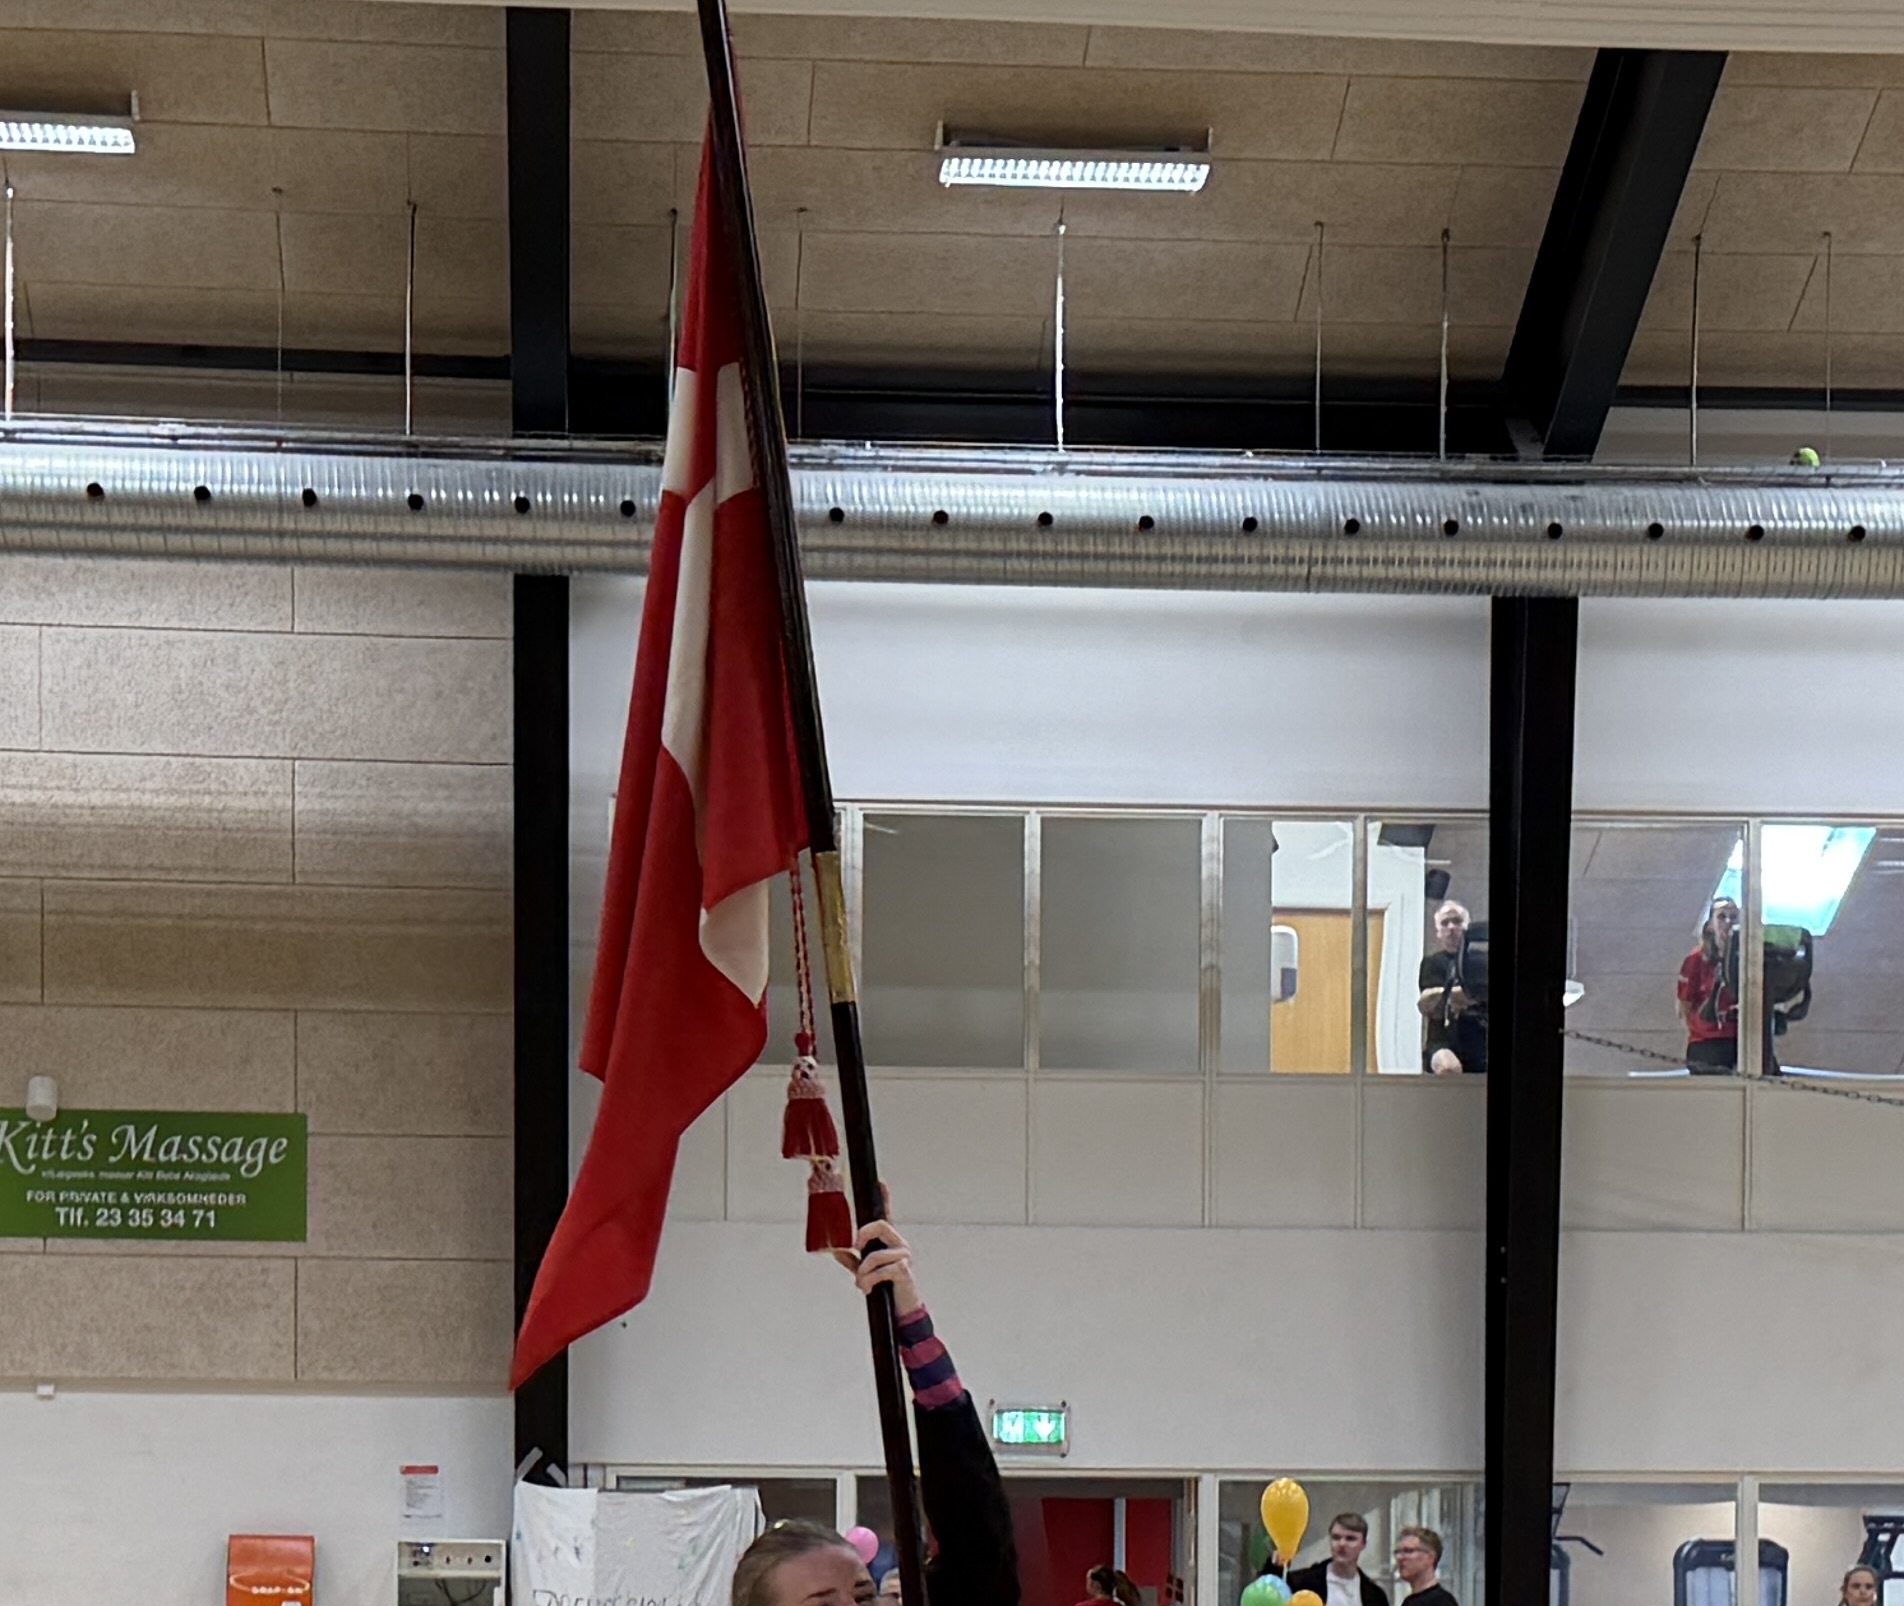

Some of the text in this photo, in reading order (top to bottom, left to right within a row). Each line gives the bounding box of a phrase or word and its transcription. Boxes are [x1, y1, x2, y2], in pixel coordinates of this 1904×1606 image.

[108, 1123, 289, 1178] Massage
[26, 1190, 56, 1202] FOR
[59, 1191, 117, 1204] PRIVATE
[55, 1206, 216, 1228] Tlf. 23 35 34 71
